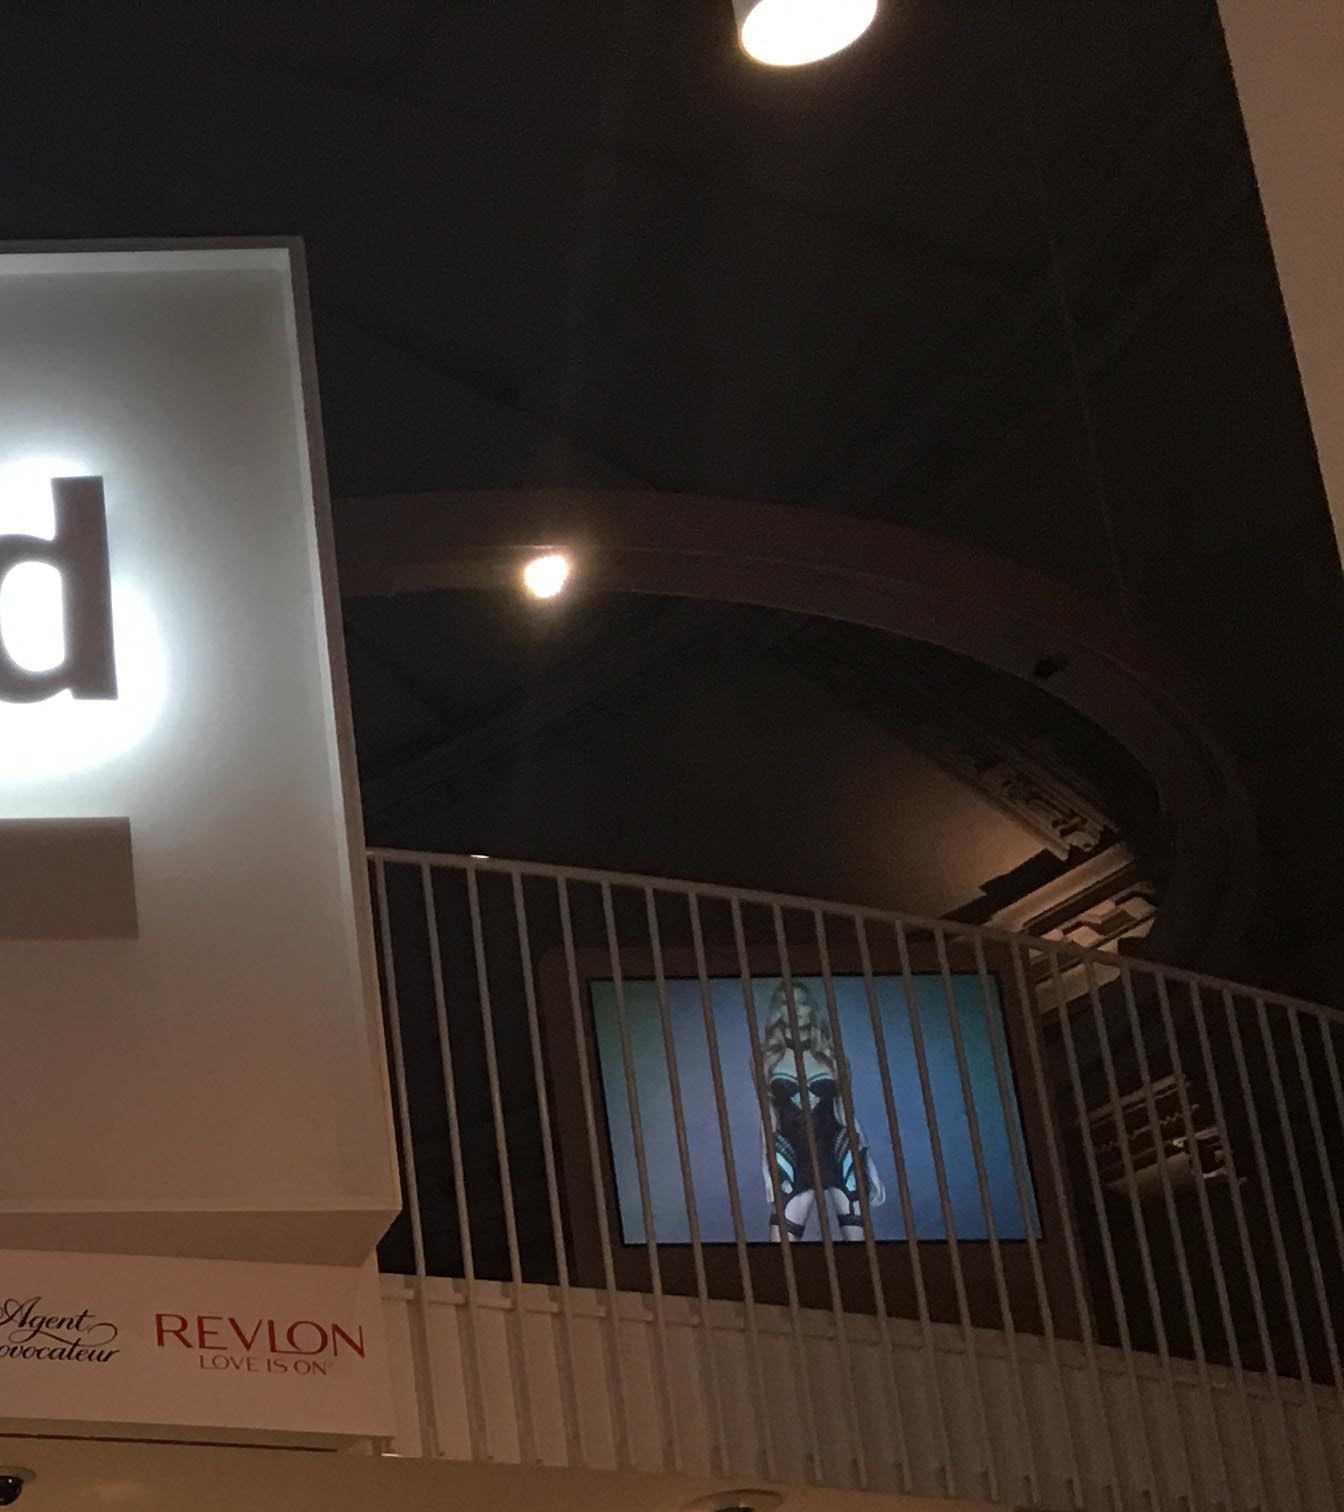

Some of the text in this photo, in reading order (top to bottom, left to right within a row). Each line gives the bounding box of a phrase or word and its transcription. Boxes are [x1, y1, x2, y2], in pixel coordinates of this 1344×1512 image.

[155, 1313, 367, 1359] REVLON
[199, 1355, 327, 1376] LOVE IS ON
